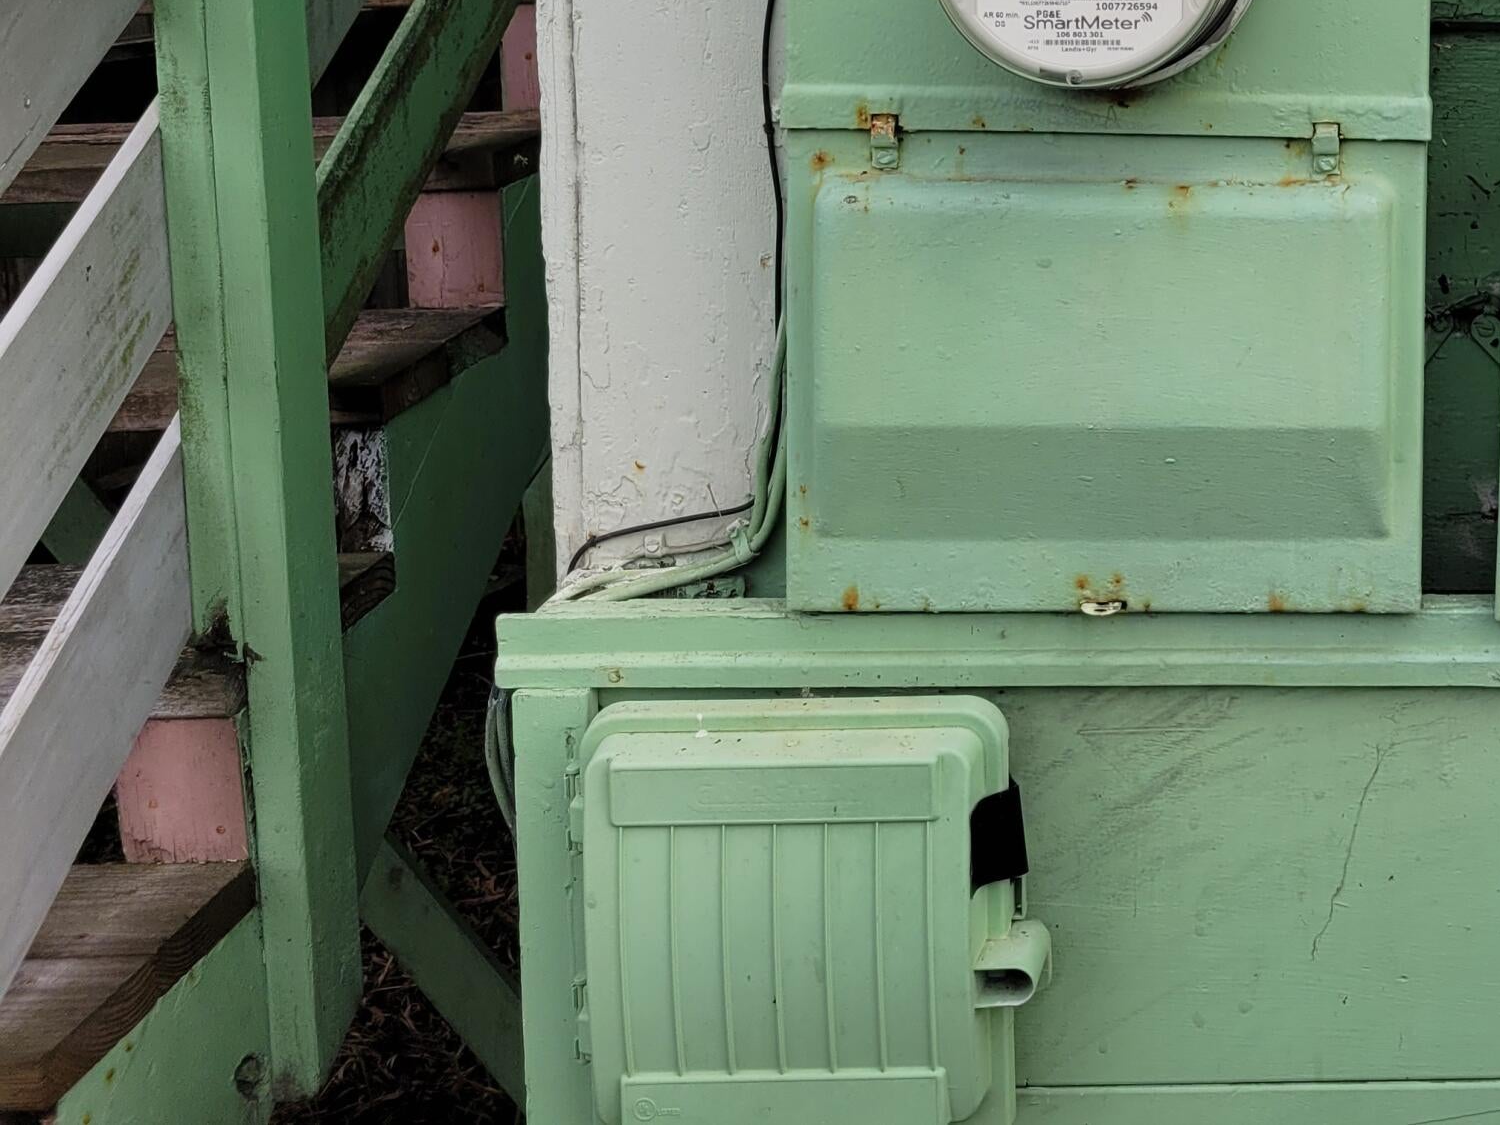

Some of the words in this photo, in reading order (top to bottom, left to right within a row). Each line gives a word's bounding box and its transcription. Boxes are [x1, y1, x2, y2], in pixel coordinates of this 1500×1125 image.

[1095, 2, 1158, 11] 1007726594
[983, 11, 994, 19] AR
[1036, 9, 1062, 18] PG&E
[1023, 14, 1141, 30] SmartMeter
